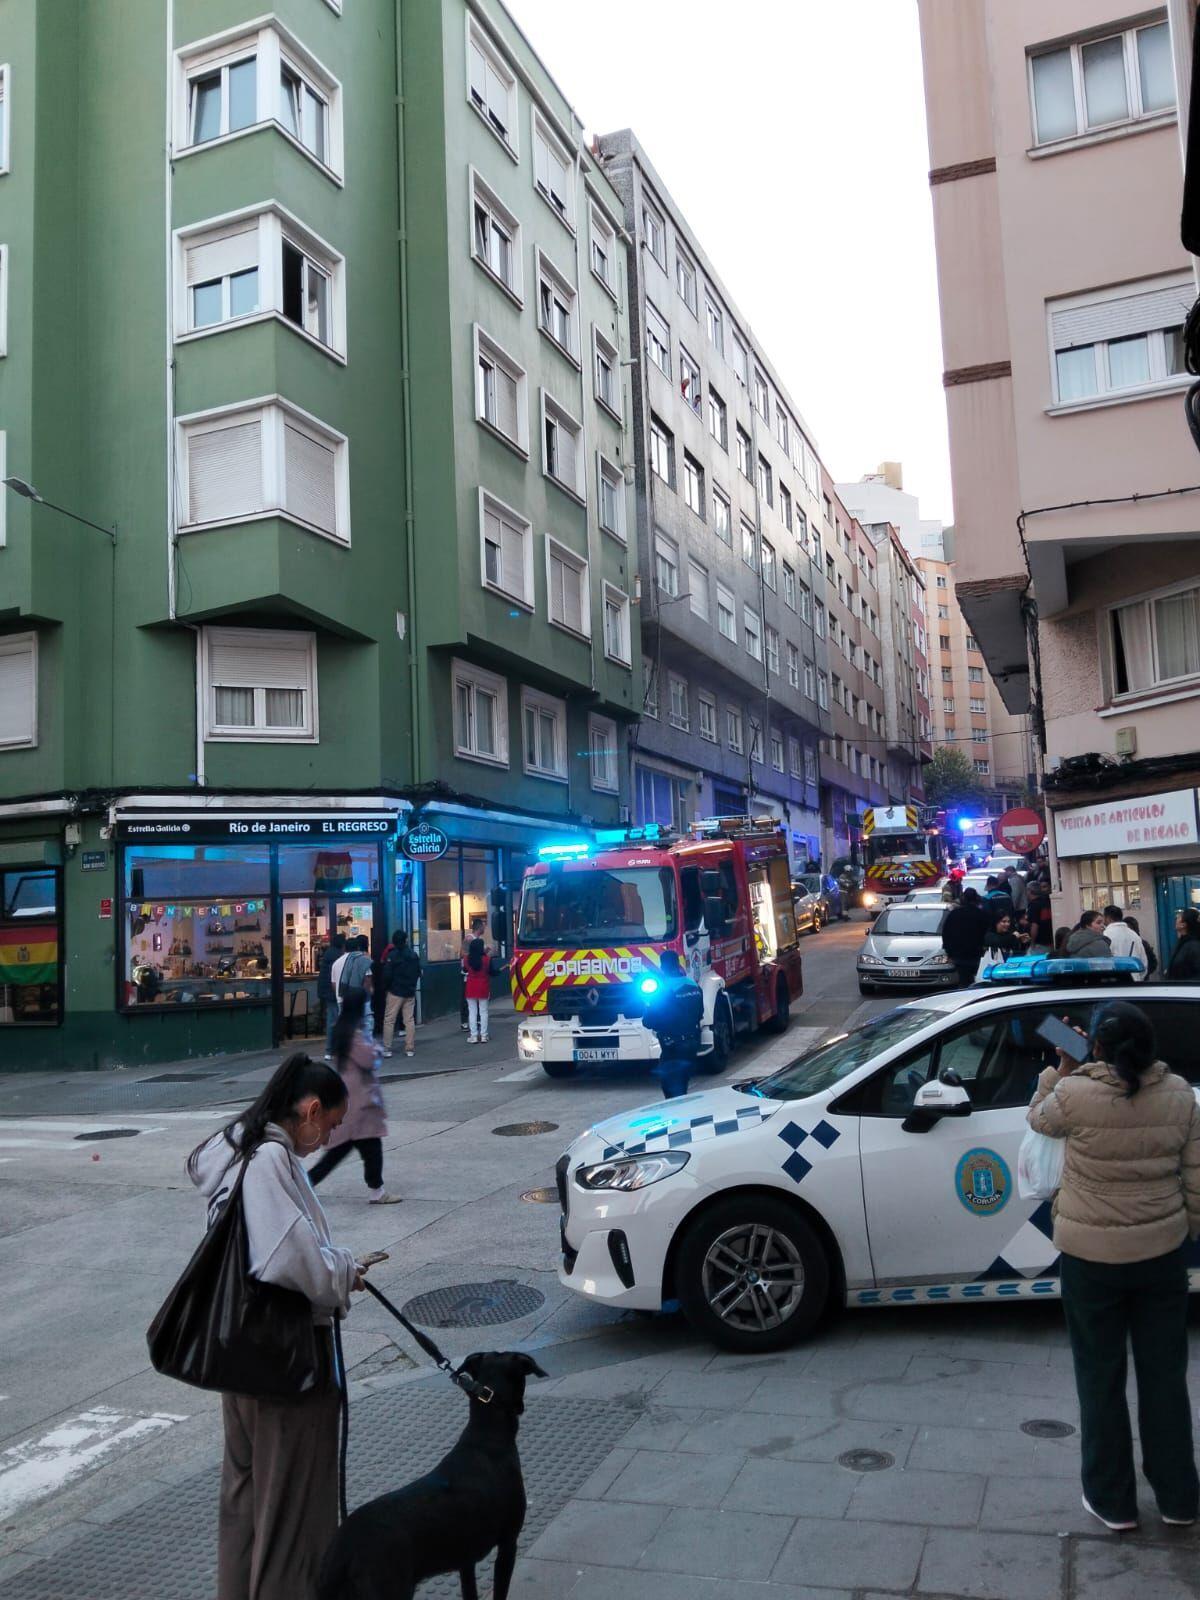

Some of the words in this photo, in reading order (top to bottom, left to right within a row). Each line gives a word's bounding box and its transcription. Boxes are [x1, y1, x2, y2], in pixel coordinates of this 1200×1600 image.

[1094, 812, 1106, 826] DE
[127, 825, 155, 833] Estrella
[155, 824, 181, 833] Galicia
[229, 821, 249, 833] Río
[251, 821, 267, 833] de
[268, 821, 311, 833] Janeiro
[322, 822, 336, 832] EL
[337, 821, 389, 832] REGRESO
[408, 833, 442, 844] Estrella
[409, 843, 441, 854] Galicia
